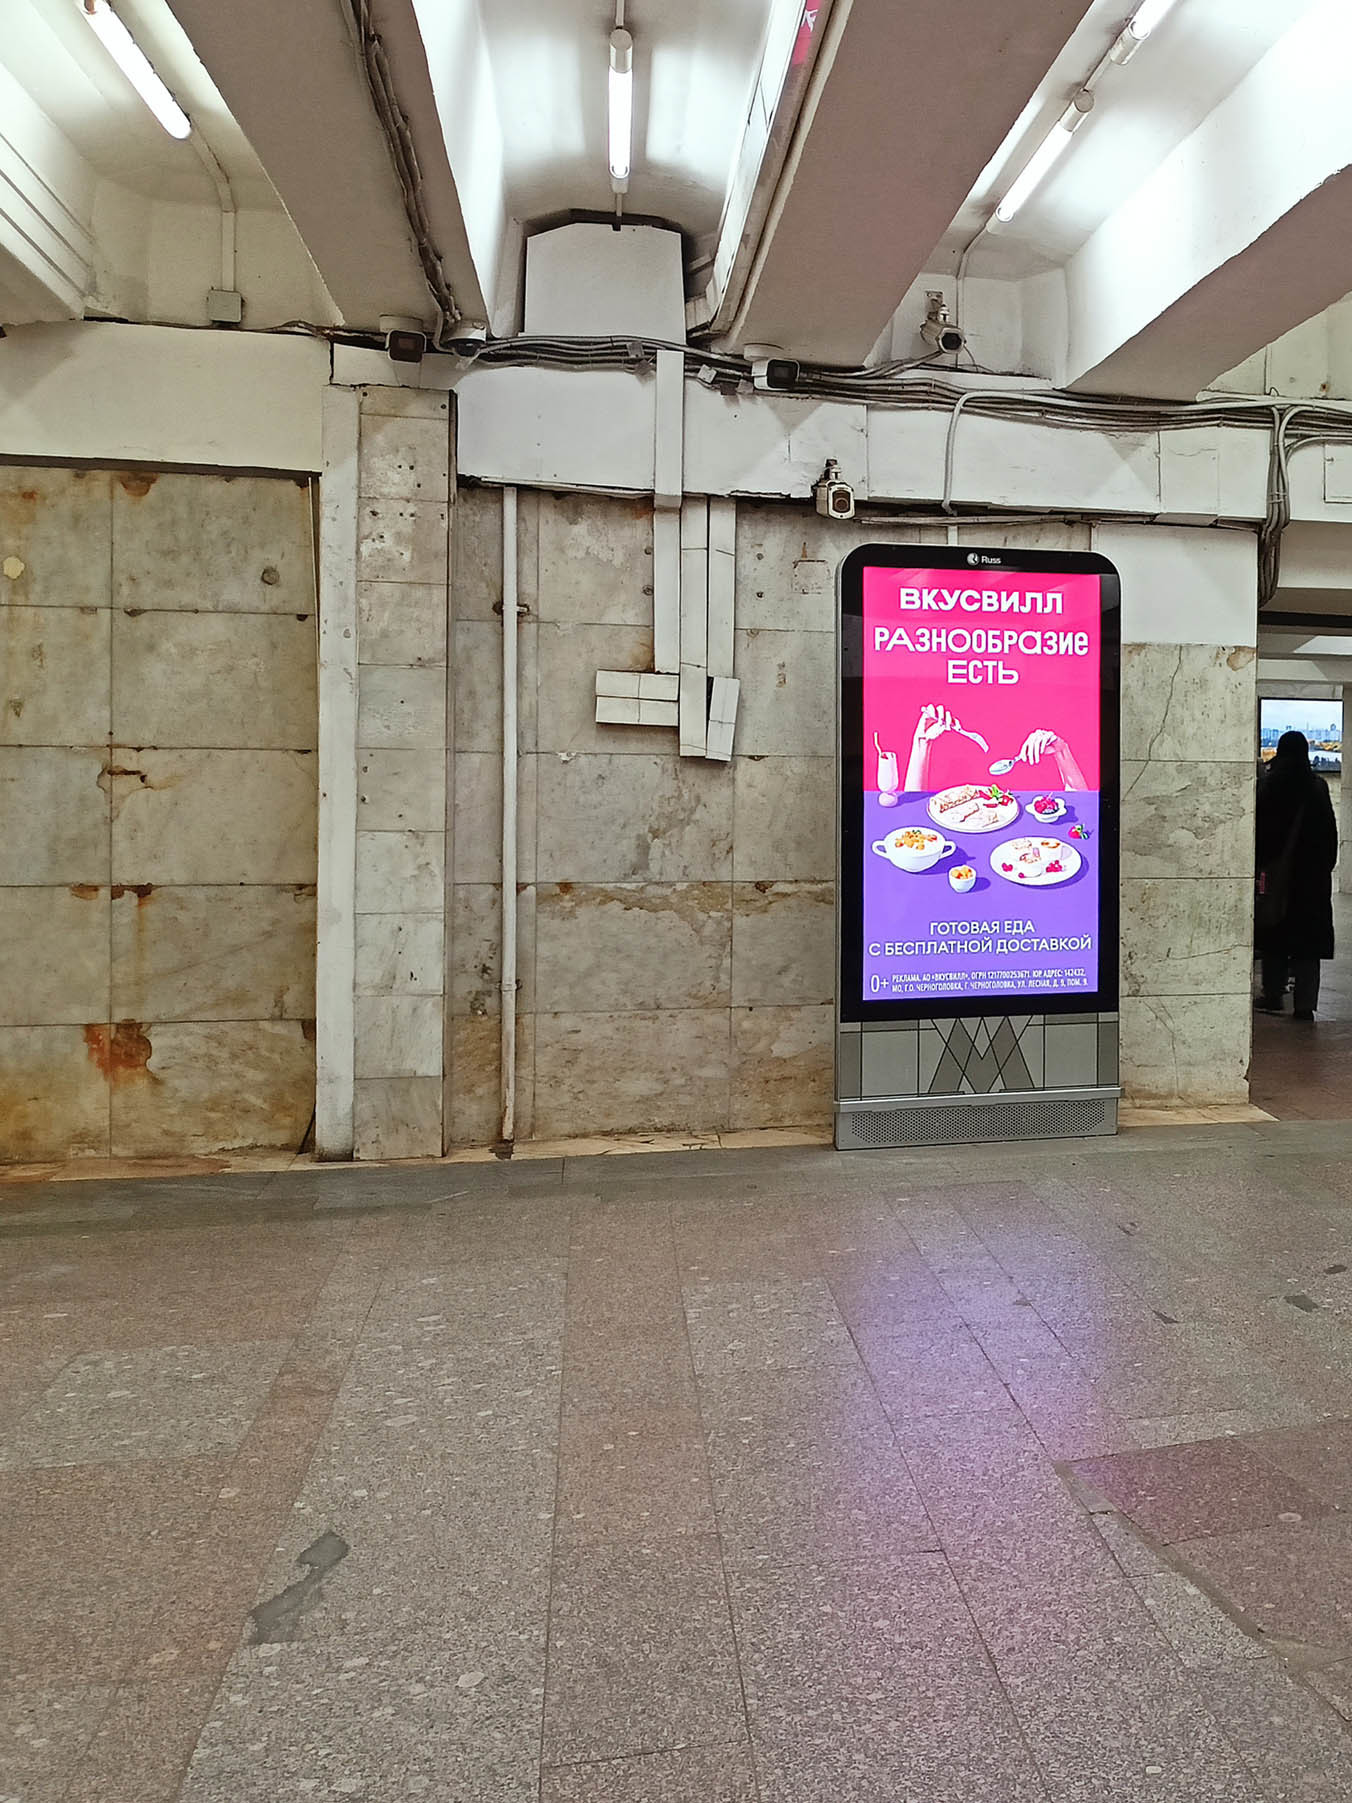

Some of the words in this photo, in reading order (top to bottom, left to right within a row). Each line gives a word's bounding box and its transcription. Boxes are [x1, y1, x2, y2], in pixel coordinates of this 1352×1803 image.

[981, 555, 1001, 564] Russ
[900, 588, 1063, 614] ВКУСВИЛЛ
[947, 660, 1020, 684] ЕСТЬ
[930, 921, 1000, 935] ГОТОВАЯ
[1004, 920, 1035, 935] ЕДА
[869, 943, 881, 956] С
[885, 936, 992, 956] БЕСПЛАТНОЙ
[996, 934, 1092, 954] ДОСТАВКОЙ
[870, 975, 889, 993] 0+
[971, 971, 987, 980] ОГРН
